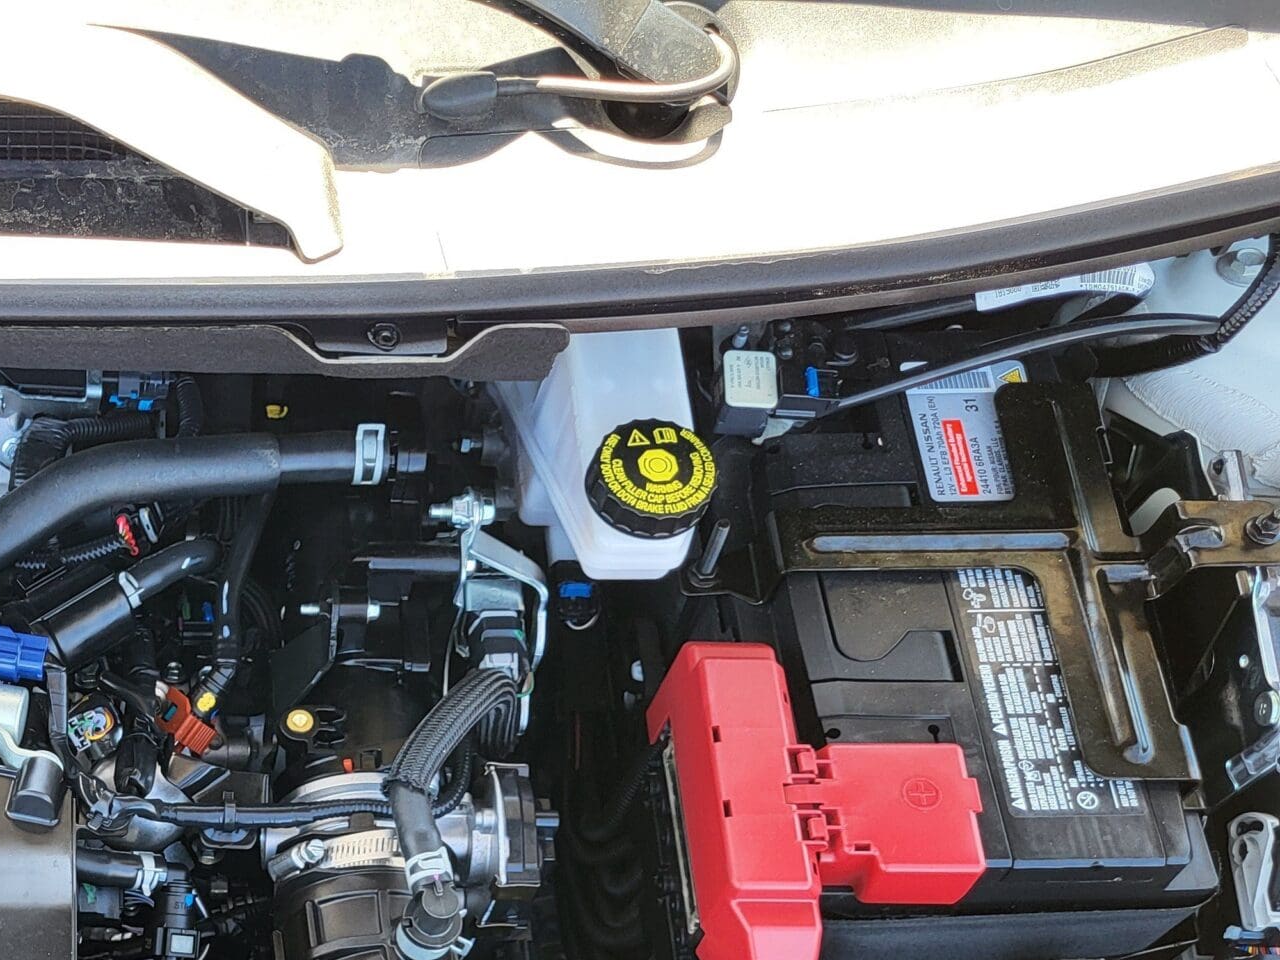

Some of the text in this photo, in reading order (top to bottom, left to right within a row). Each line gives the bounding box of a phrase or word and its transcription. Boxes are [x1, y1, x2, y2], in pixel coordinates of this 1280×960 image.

[927, 396, 937, 410] (EN)
[963, 398, 978, 411] 31
[930, 412, 940, 429] 720A
[605, 434, 621, 448] USE
[680, 429, 713, 462] CONTAINER
[600, 446, 613, 462] ONLY
[919, 413, 945, 495] RENAULT NISSAN
[940, 450, 949, 464] EFB
[970, 437, 991, 493] 24410 6RA3A
[612, 452, 704, 504] CLEAN FILLER CAP BEFORE REMOVING
[703, 462, 716, 488] SEALED
[608, 481, 620, 494] OR
[646, 480, 682, 493] WARNING
[700, 486, 710, 494] A
[948, 483, 956, 494] 12V
[686, 490, 707, 508] FROM
[636, 500, 664, 514] BRAKE
[664, 501, 688, 514] FLUID
[979, 664, 1022, 797] DANGER/POISON PELIGRO/VENENO
